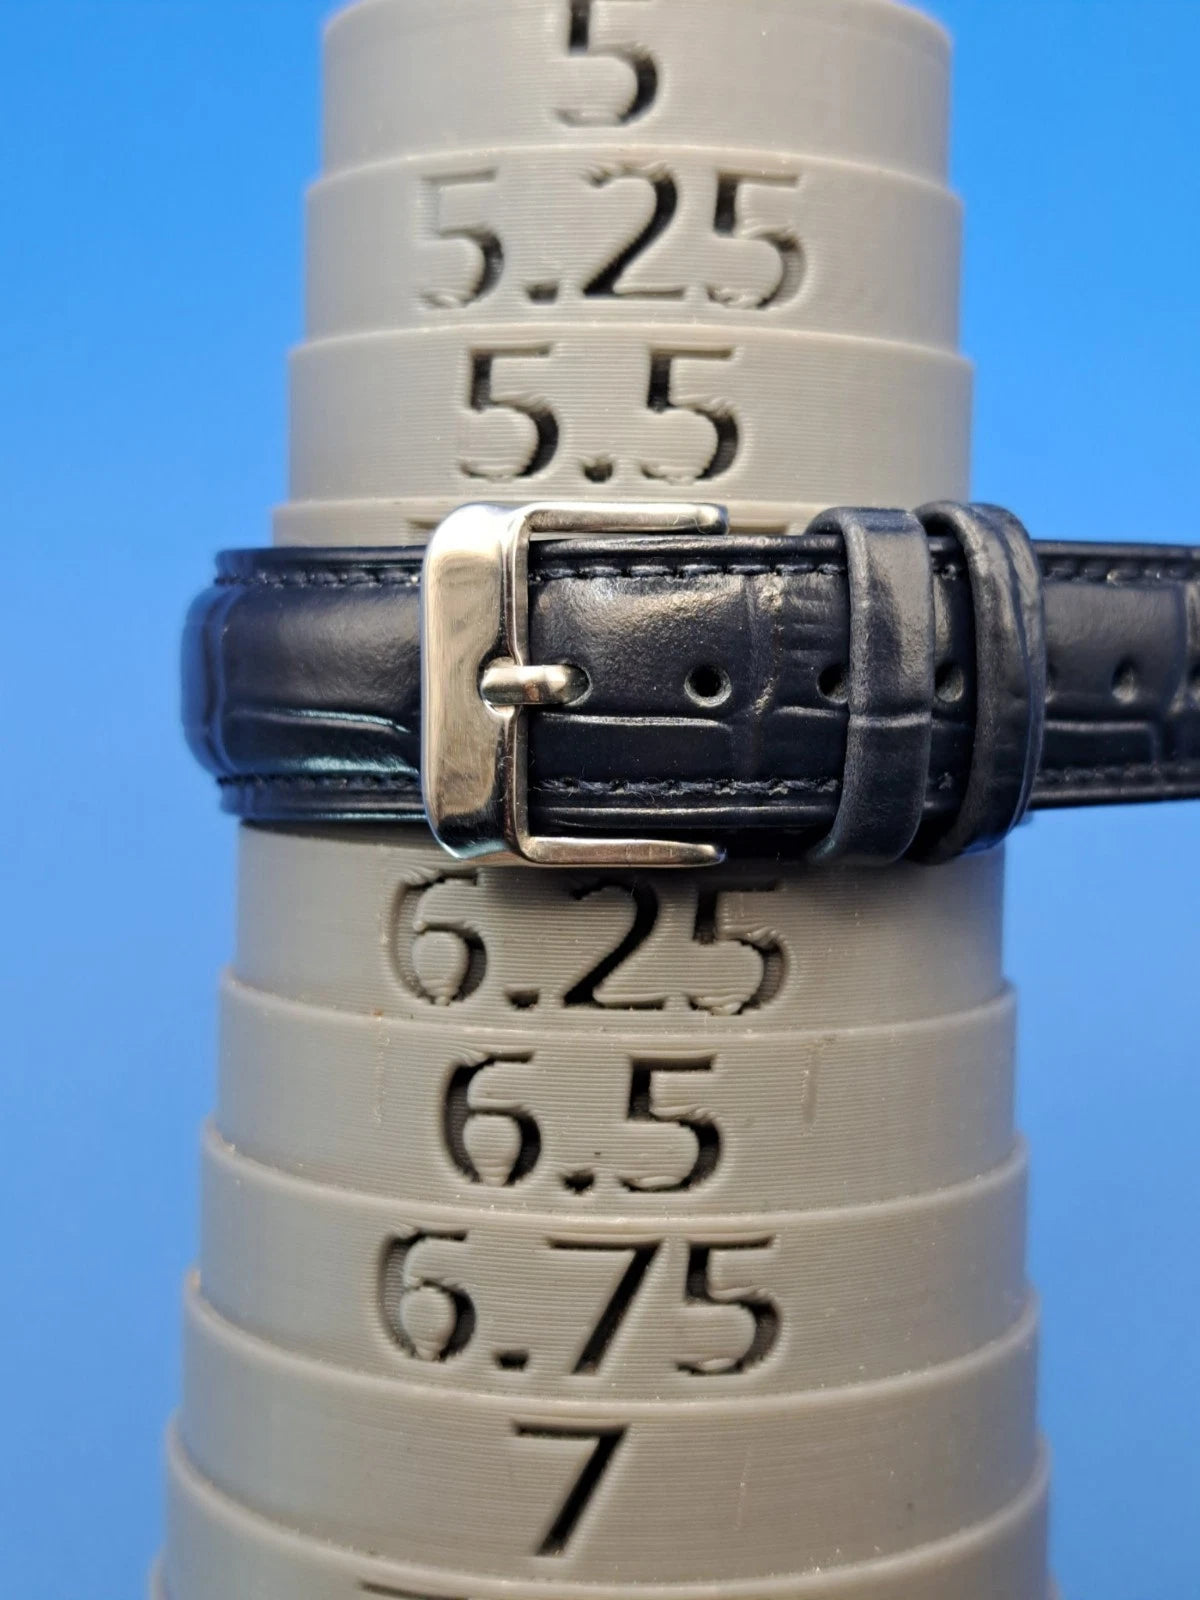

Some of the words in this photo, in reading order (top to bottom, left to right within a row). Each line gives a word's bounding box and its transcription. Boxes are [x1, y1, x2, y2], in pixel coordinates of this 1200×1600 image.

[556, 0, 659, 127] 5
[414, 160, 808, 310] 5.25
[458, 343, 741, 484] 5.5
[389, 868, 793, 1016] 6.25
[442, 1051, 722, 1193] 6.5
[377, 1229, 783, 1376] 6.75
[509, 1420, 631, 1557] 7
